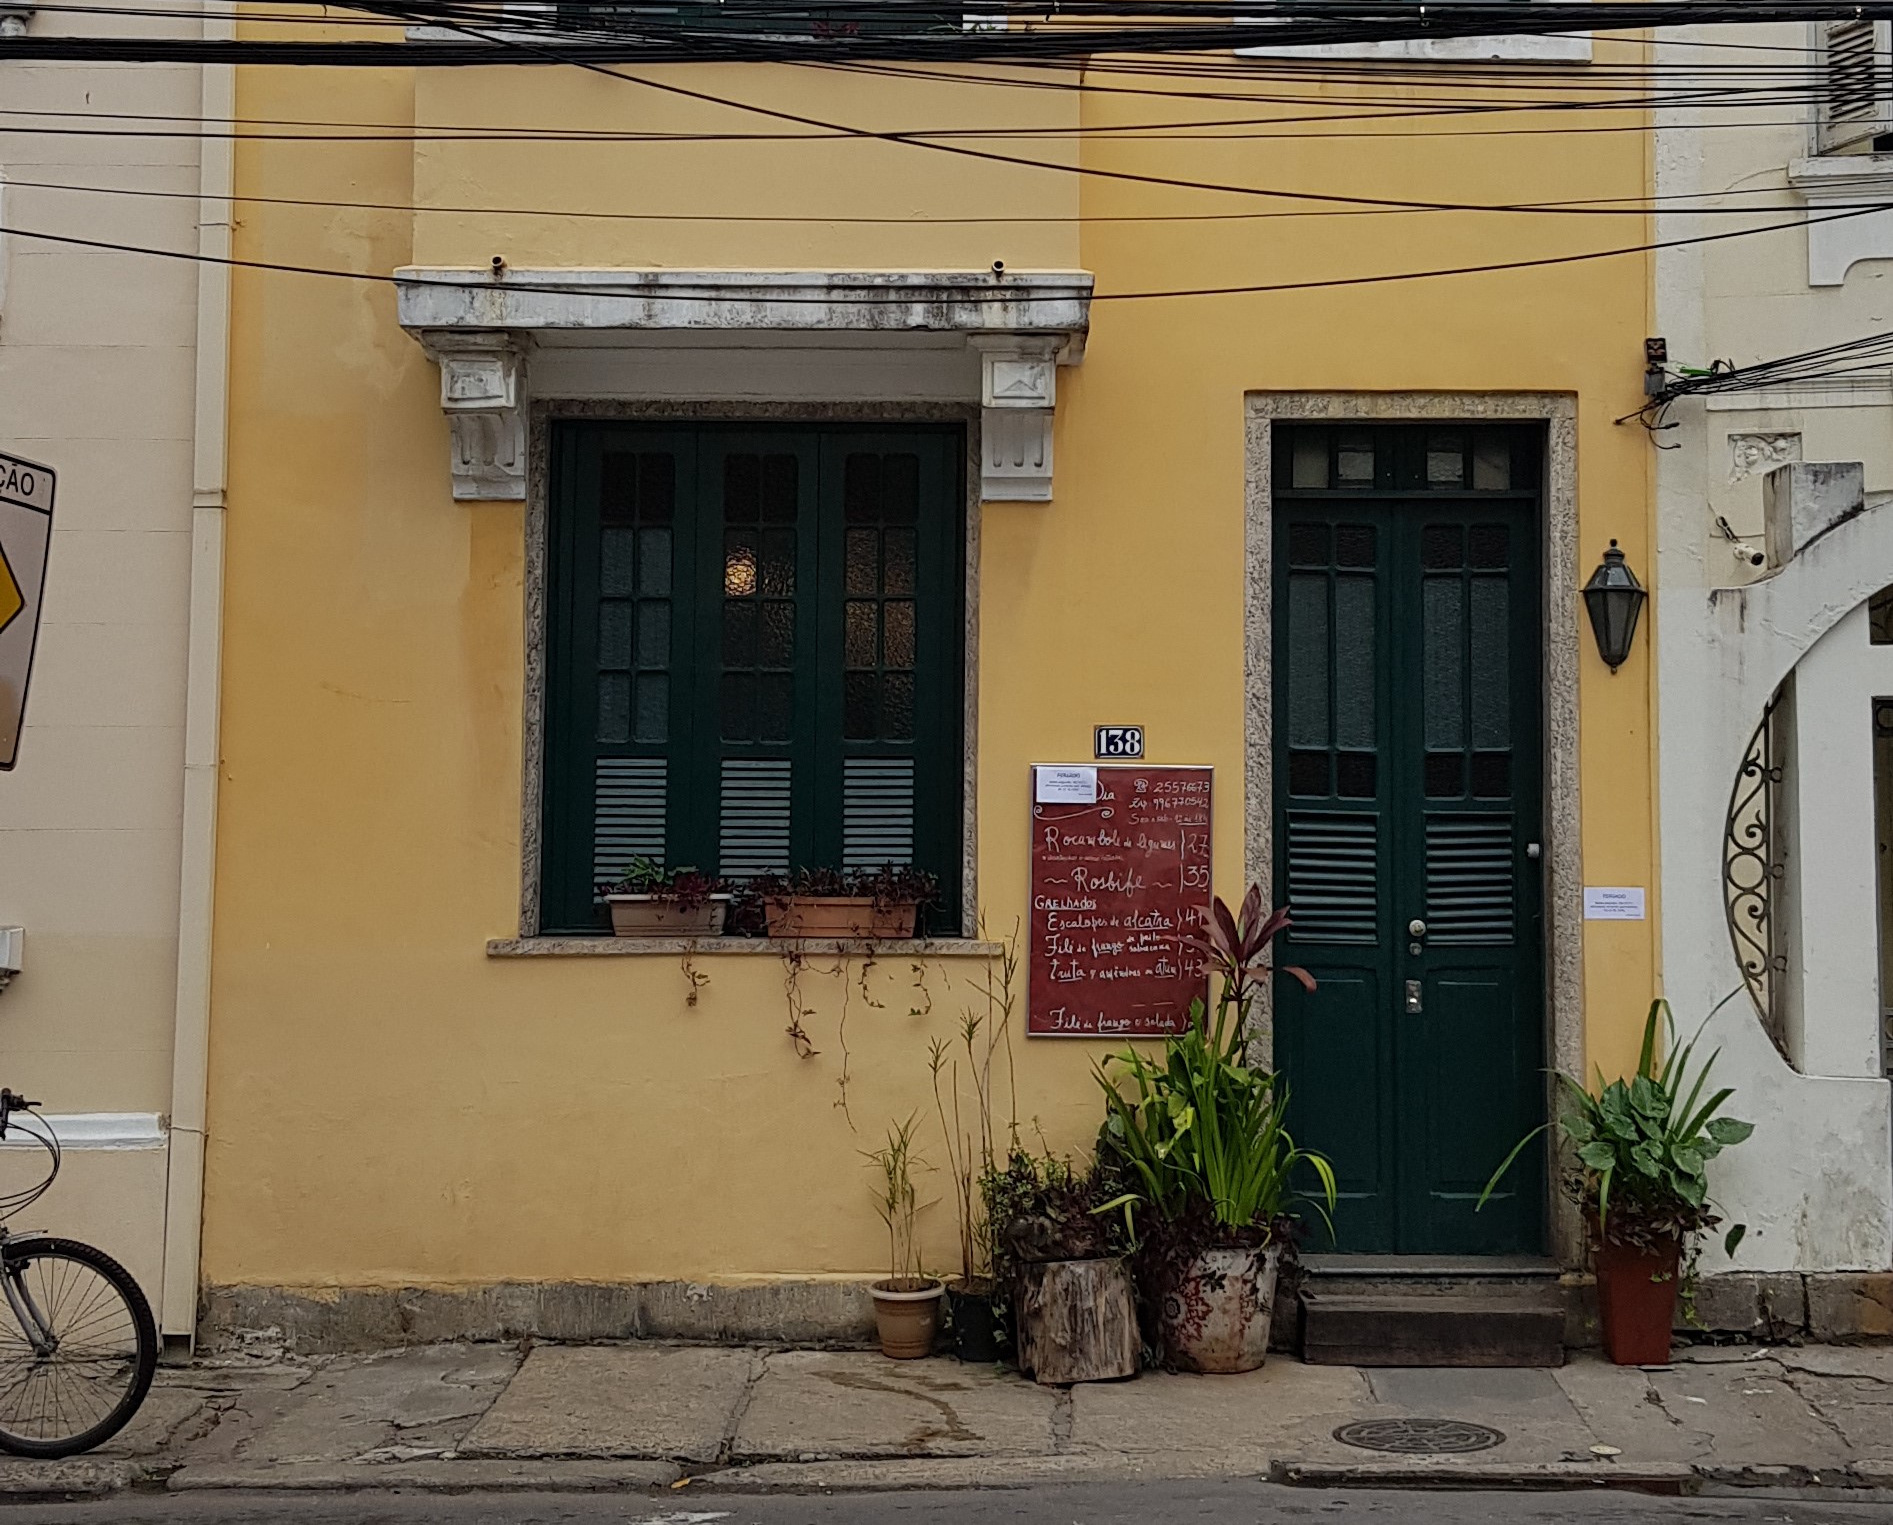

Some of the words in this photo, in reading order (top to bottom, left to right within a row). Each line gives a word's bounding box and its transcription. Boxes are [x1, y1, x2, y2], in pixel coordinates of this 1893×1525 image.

[1099, 729, 1141, 754] 138
[1071, 866, 1147, 898] Rosbife
[1047, 912, 1108, 932] Escalopes
[1124, 909, 1174, 929] alcatra
